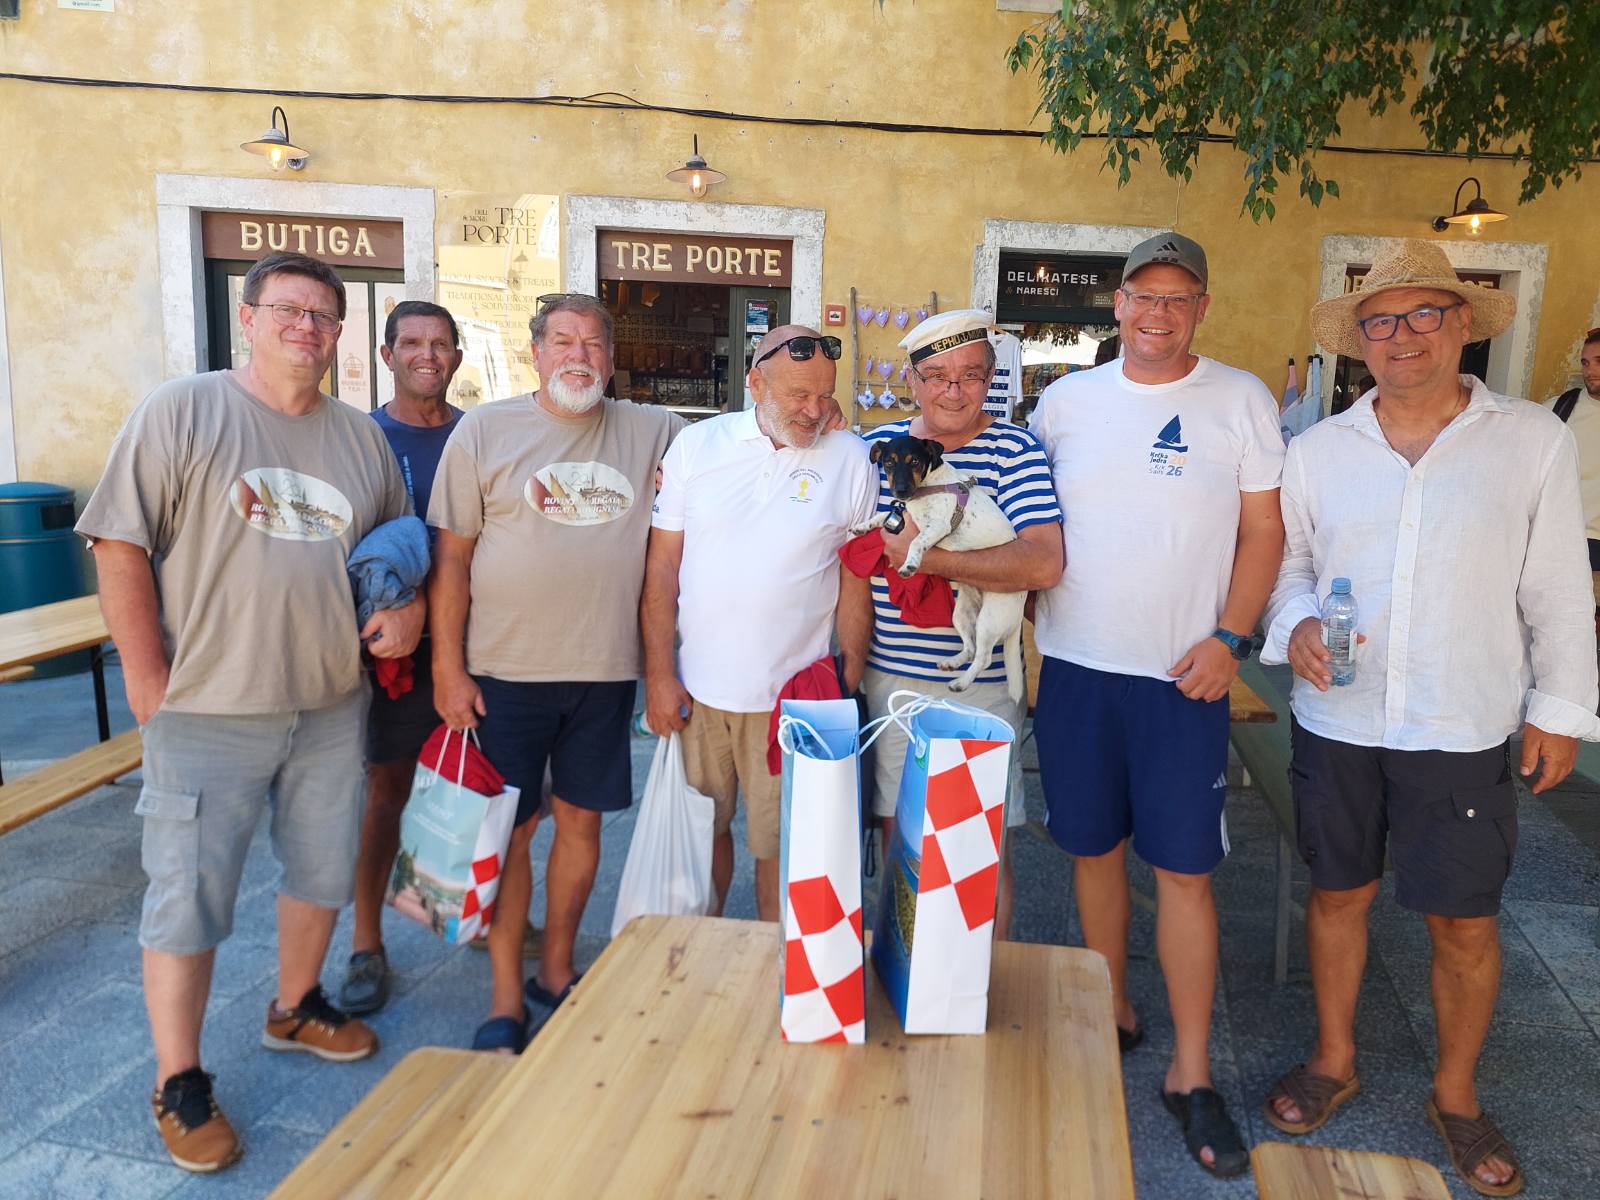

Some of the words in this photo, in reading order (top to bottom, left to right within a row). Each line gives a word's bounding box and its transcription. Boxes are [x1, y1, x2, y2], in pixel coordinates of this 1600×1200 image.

[494, 207, 537, 227] TRE
[239, 221, 377, 258] BUTIGA
[463, 224, 537, 246] PORTE
[611, 241, 673, 272] TRE
[686, 245, 782, 277] PORTE
[523, 279, 555, 287] TREATS
[1007, 271, 1099, 285] DELIKATESE
[1166, 465, 1184, 477] 26
